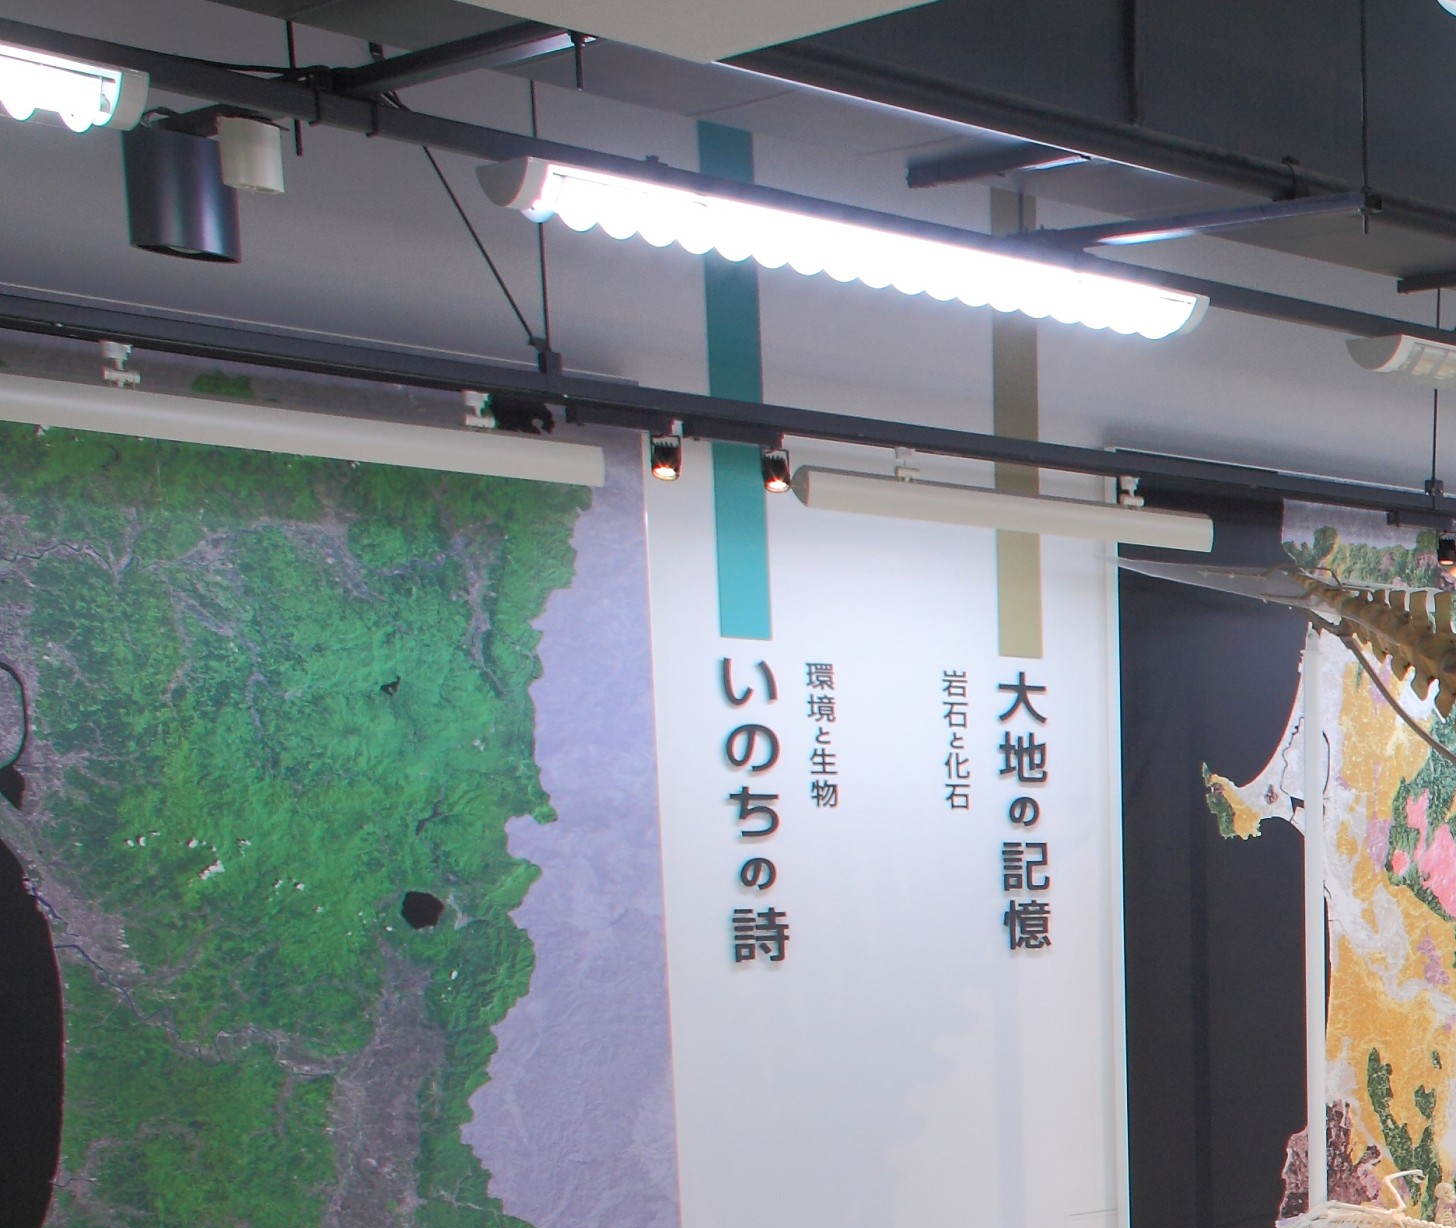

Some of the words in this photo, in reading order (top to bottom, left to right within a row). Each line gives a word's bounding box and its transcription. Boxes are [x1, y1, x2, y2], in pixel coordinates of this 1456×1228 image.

[721, 656, 791, 964] いのちの詩
[805, 661, 839, 809] 環境と生物
[942, 669, 972, 811] 岩石と化石
[998, 671, 1053, 951] 大地の記憶
